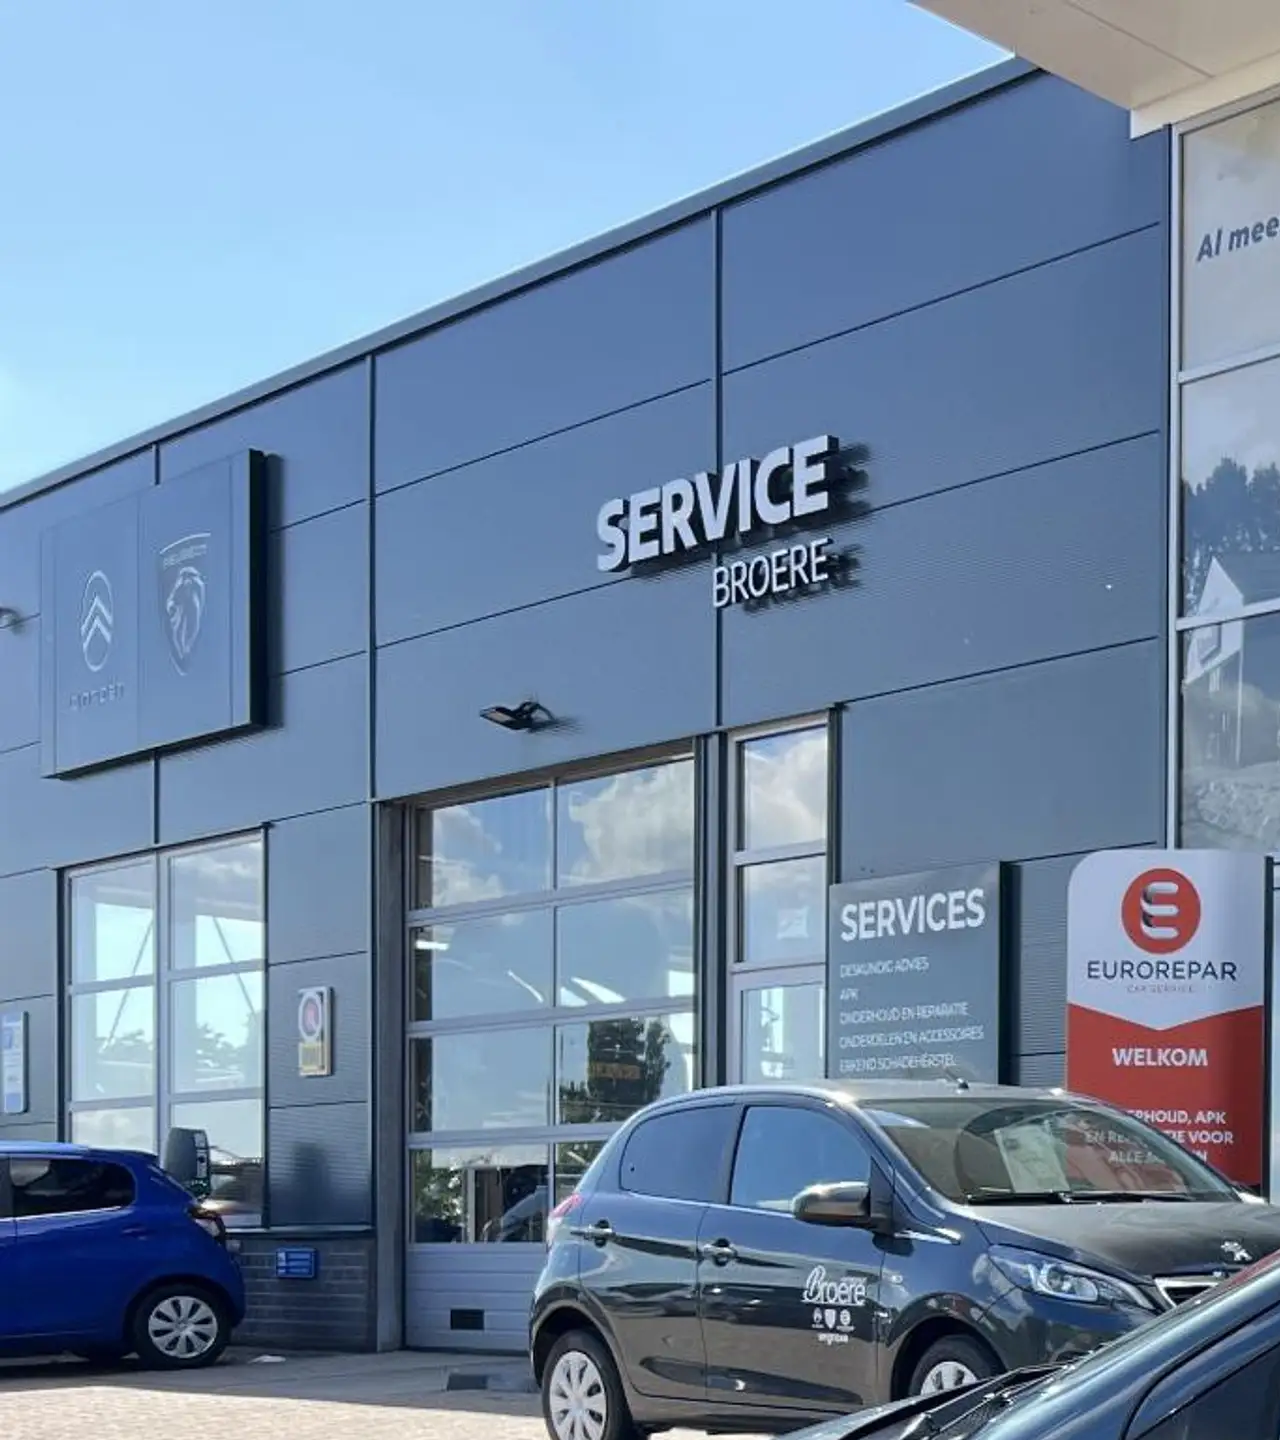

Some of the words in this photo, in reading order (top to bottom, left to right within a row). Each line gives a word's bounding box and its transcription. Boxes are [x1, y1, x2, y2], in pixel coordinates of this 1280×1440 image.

[1196, 229, 1223, 263] Al
[596, 433, 830, 572] SERVICE
[711, 537, 829, 609] BROERE
[840, 887, 986, 942] SERVICES
[1086, 959, 1238, 981] EUROREPAR
[1111, 1047, 1209, 1067] WELKOM
[1194, 1110, 1227, 1125] APK
[1188, 1130, 1235, 1145] VOOR
[801, 1265, 866, 1306] Broere
